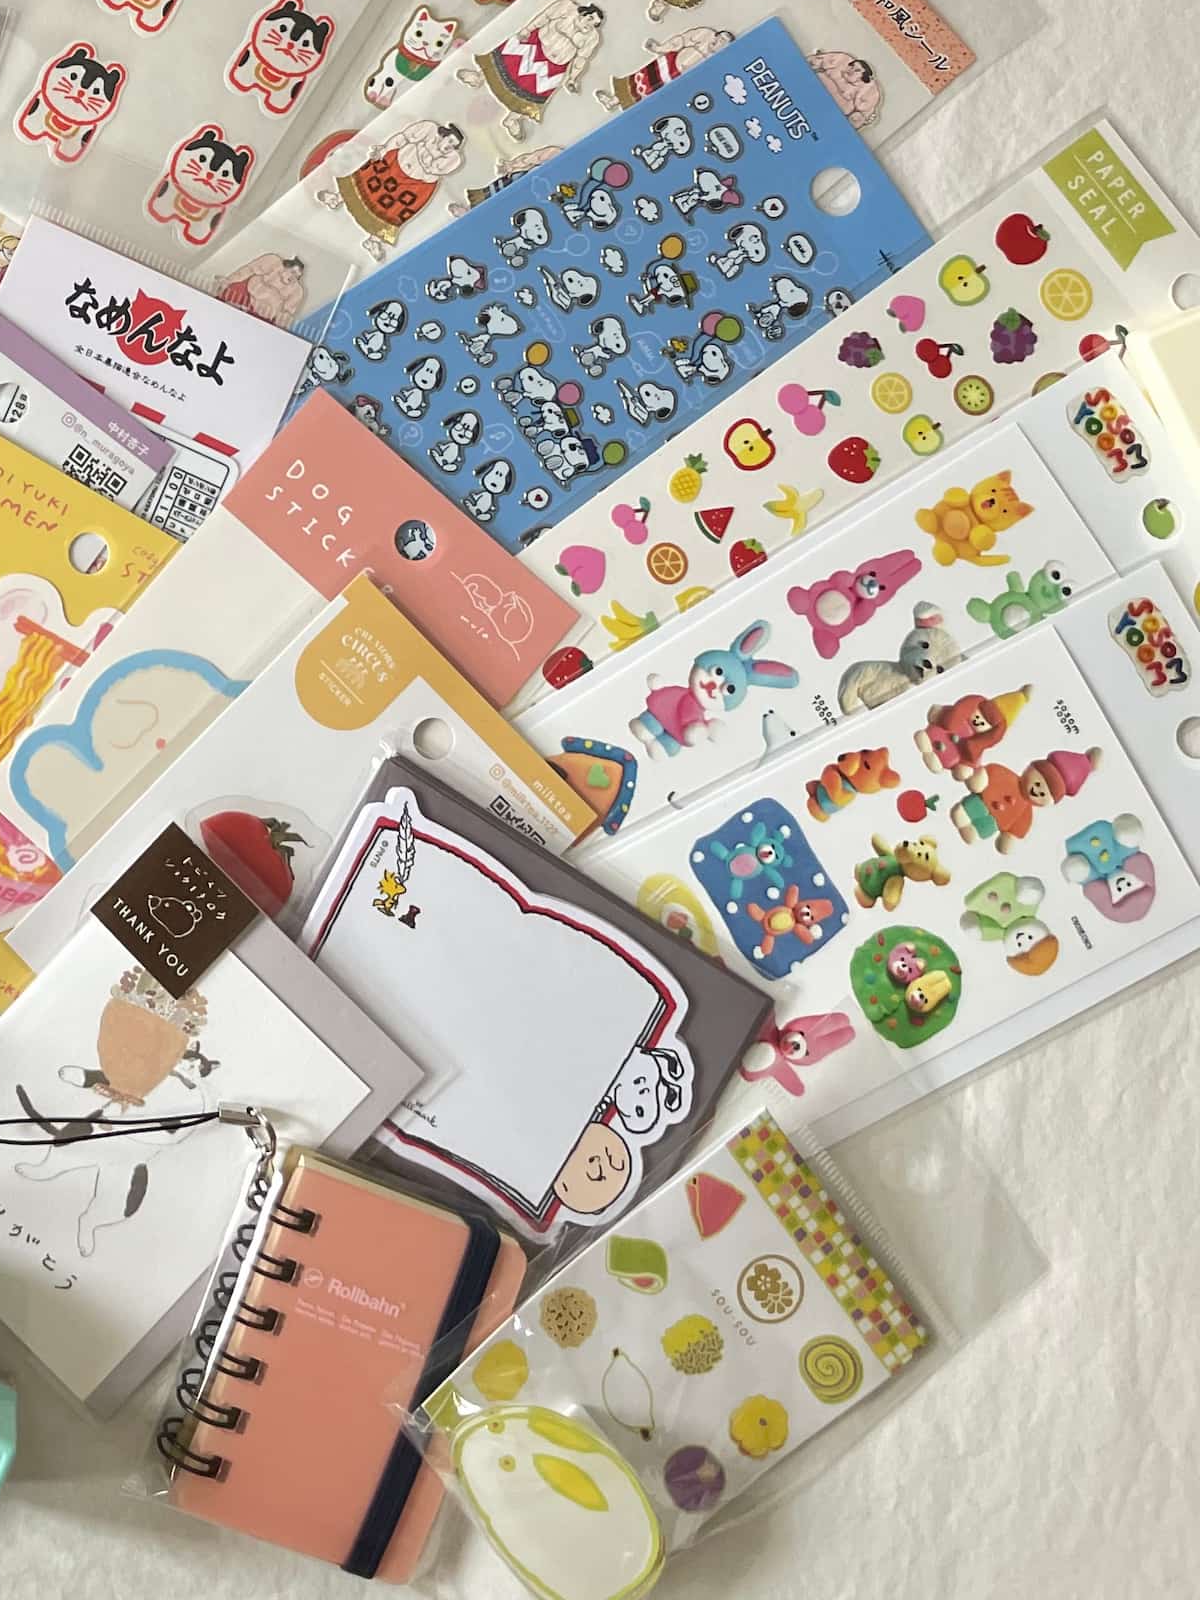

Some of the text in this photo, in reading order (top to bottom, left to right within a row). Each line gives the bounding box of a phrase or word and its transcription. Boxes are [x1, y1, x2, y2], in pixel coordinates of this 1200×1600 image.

[744, 57, 811, 142] PEANUTS
[1067, 173, 1114, 236] SEAL
[1087, 149, 1145, 221] PAPER
[64, 277, 235, 387] なめんなよ
[21, 480, 71, 517] YUKI
[286, 459, 353, 526] DOG
[531, 779, 573, 823] milktea
[112, 896, 190, 979] THANK YOU
[327, 1277, 401, 1319] Rollbahn
